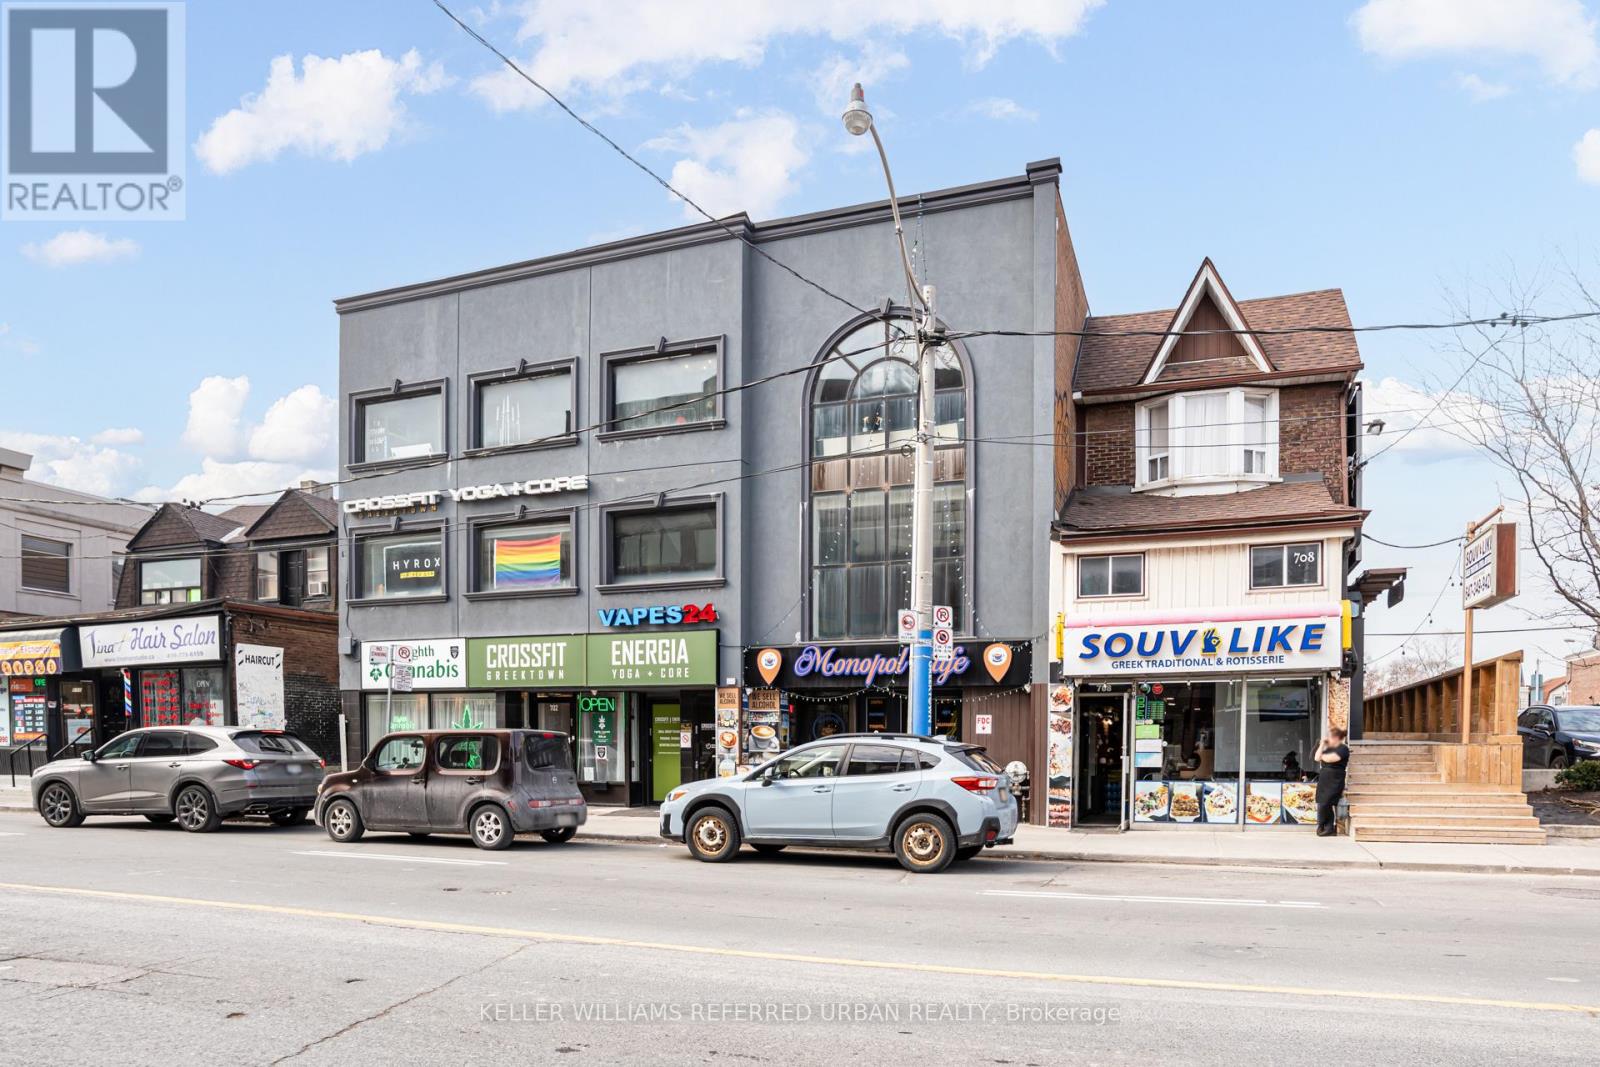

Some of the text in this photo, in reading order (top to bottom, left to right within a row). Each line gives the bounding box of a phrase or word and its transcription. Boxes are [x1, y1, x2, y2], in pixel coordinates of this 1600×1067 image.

[343, 490, 441, 513] CROSSFIT
[448, 483, 509, 502] YOGA
[524, 475, 589, 495] CORE
[392, 557, 441, 570] HYROX
[1293, 551, 1315, 564] 708
[597, 603, 718, 627] VAPES24
[130, 626, 167, 651] Hair
[169, 623, 216, 650] Salon
[1078, 623, 1327, 660] SOUV LIKE
[412, 644, 435, 660] ghth
[486, 642, 567, 669] CROSSFIT
[611, 638, 689, 666] ENERGIA
[245, 654, 275, 666] HAIRCUT
[932, 645, 970, 686] afe
[1111, 655, 1285, 670] GREEK TRADITIONAL & ROTISSERIE
[385, 659, 459, 678] Cnabis
[486, 669, 565, 681] GREEKTOWN
[612, 668, 640, 679] YOGA
[660, 667, 690, 679] CORE
[762, 691, 776, 700] SELL
[580, 697, 616, 712] OPEN
[752, 701, 776, 709] ALCOHOL
